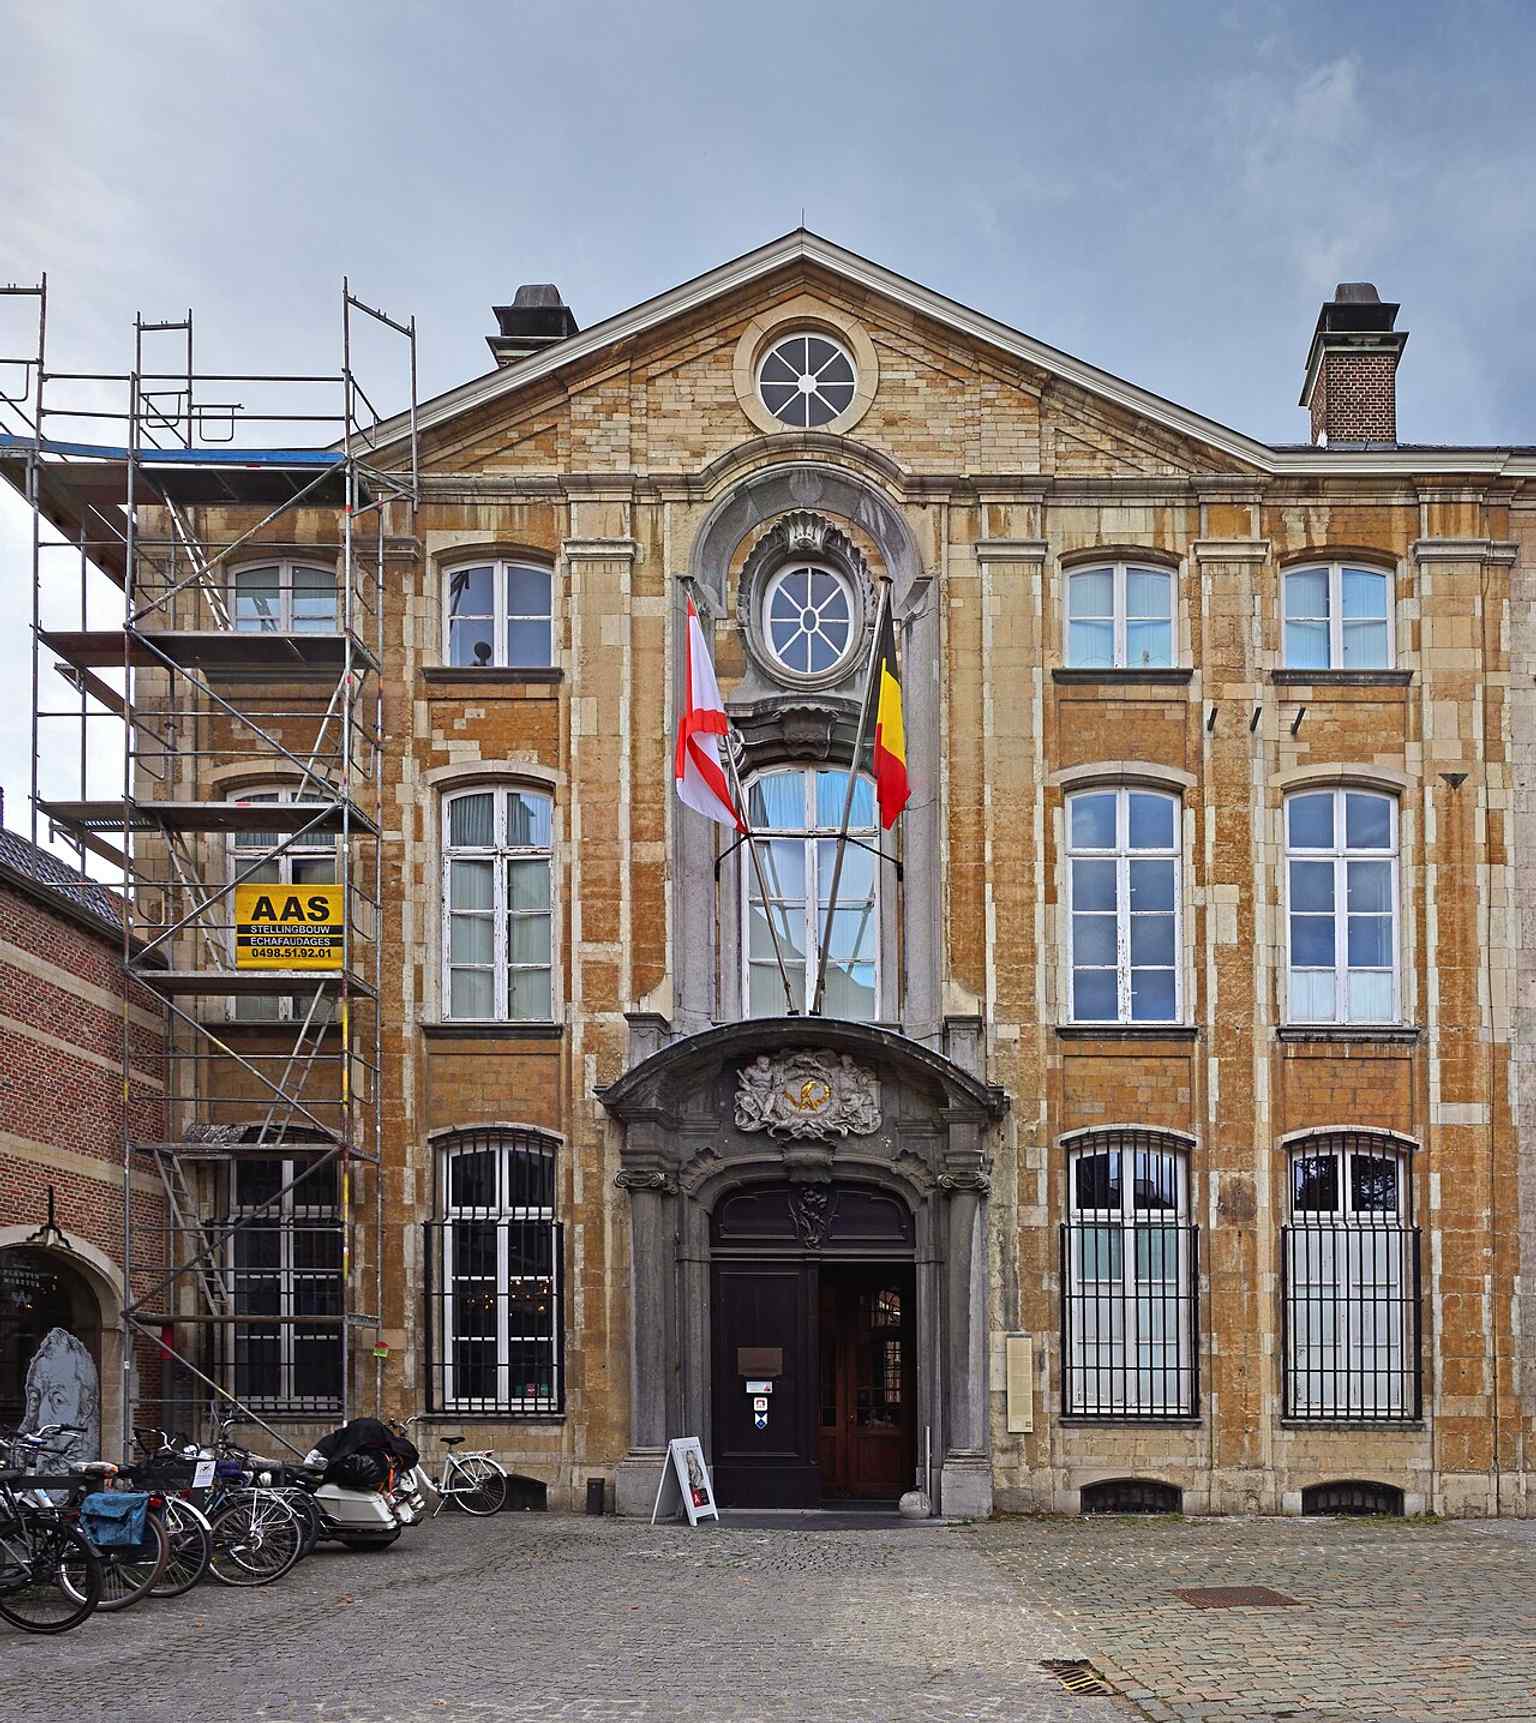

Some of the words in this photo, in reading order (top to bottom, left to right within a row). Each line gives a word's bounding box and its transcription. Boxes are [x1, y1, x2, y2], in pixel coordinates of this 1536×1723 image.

[251, 896, 330, 922] AAS
[250, 926, 330, 934] STELLINGBOUW
[250, 938, 331, 946] ECHAFAUDAGES
[251, 948, 332, 958] 0498.51.92.01
